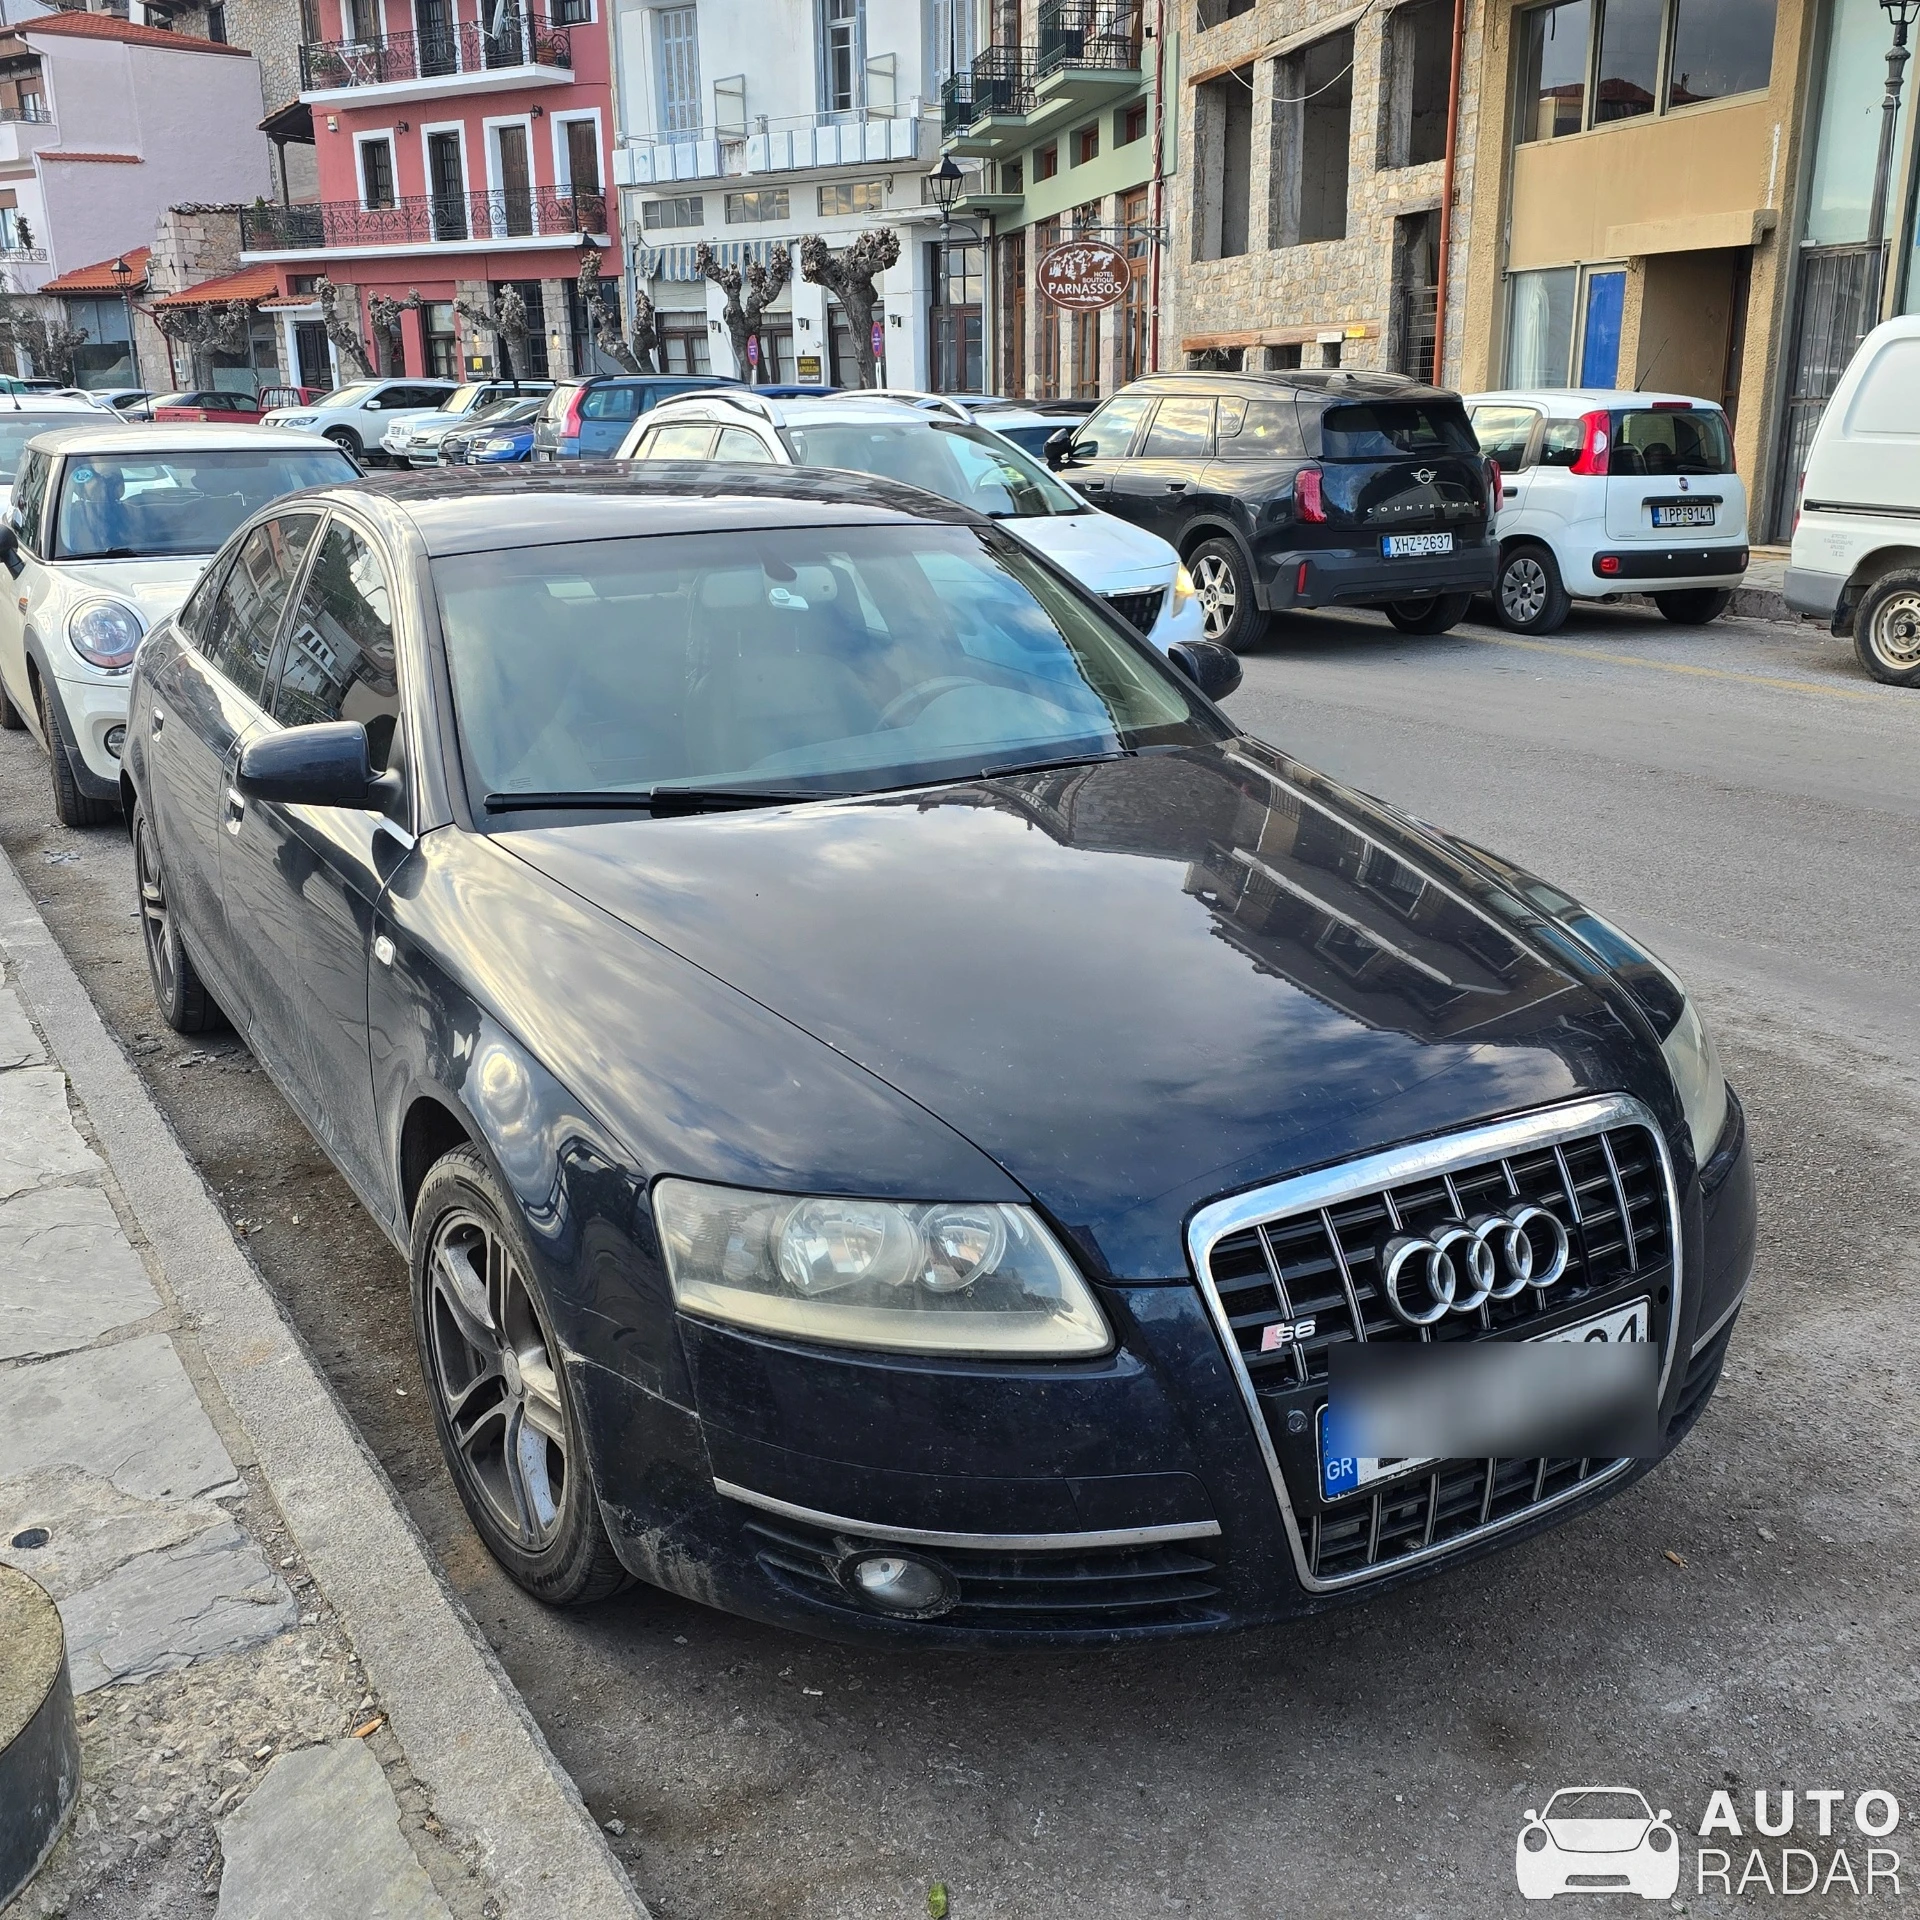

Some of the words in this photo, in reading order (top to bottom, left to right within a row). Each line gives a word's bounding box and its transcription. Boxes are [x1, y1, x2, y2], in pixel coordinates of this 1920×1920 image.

[1048, 282, 1122, 294] PARNASSOS
[1367, 500, 1479, 513] COUNTRYMAN
[1275, 1320, 1316, 1342] S6
[1326, 1457, 1354, 1481] GR
